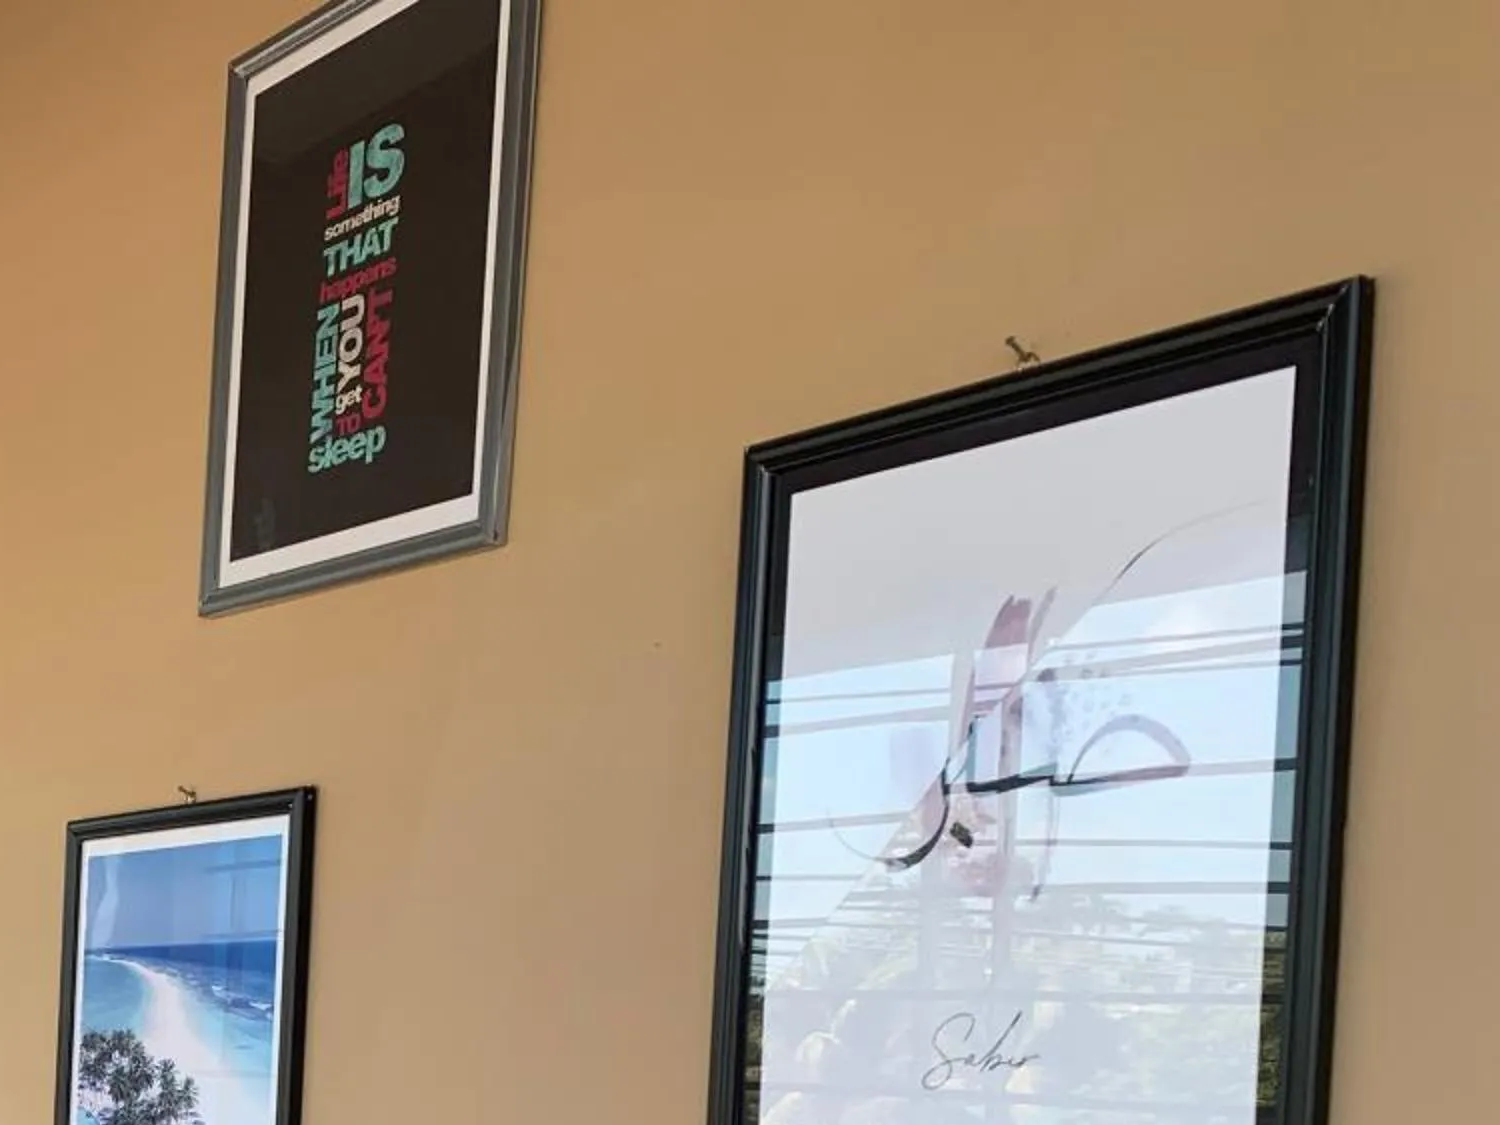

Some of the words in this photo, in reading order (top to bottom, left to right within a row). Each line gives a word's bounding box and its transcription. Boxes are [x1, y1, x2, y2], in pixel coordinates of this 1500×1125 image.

[348, 124, 404, 210] IS
[323, 195, 400, 241] something
[323, 217, 399, 278] THAT
[320, 257, 397, 304] happens
[336, 294, 365, 394] YOU
[309, 303, 340, 444] WHEN
[335, 384, 362, 415] get
[307, 425, 386, 473] sleep
[336, 413, 361, 437] TO
